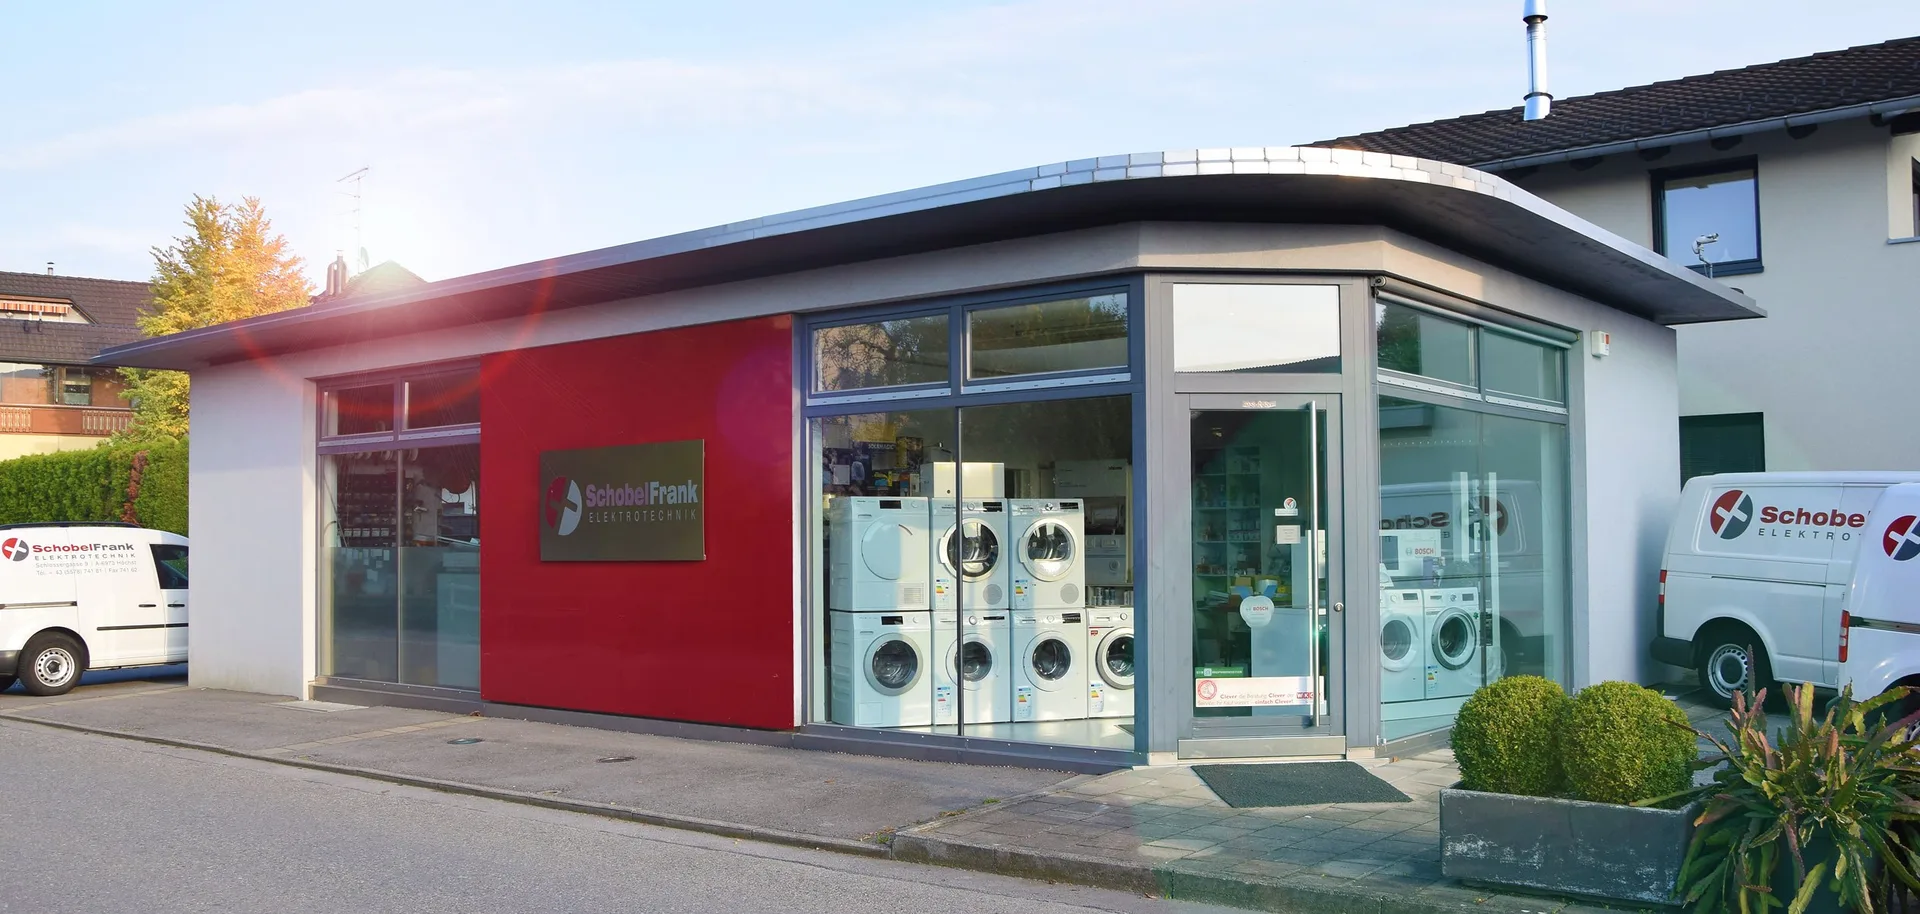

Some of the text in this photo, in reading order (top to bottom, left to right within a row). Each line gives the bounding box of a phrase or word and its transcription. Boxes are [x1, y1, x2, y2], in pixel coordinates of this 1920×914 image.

[585, 479, 698, 507] SchobelFrank
[589, 509, 696, 523] ELEKTROTECHNIK
[1760, 505, 1870, 528] Schobe
[1758, 528, 1862, 541] ELEKTRO
[32, 543, 134, 553] SchobelFrank
[1414, 547, 1434, 555] BOSCH
[35, 553, 136, 561] ELEKTROTECHNIK
